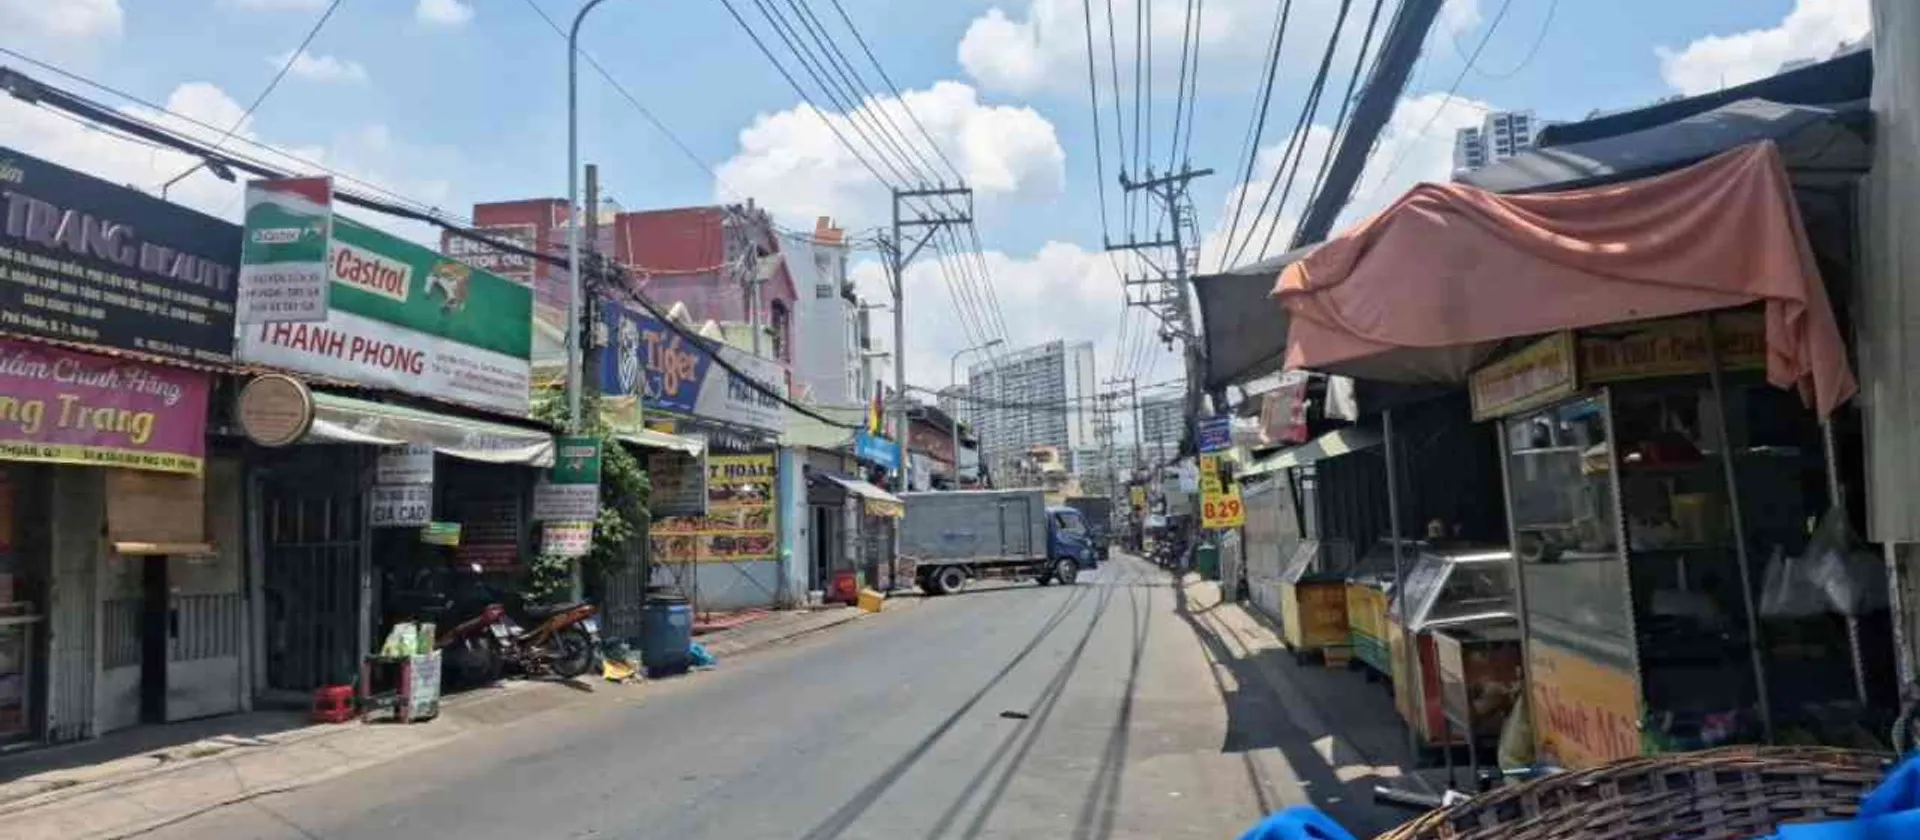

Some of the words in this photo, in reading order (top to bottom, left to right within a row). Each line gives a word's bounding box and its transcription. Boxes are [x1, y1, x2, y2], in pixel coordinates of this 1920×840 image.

[4, 191, 136, 267] TRANG
[139, 241, 232, 292] BEAUTY
[335, 249, 407, 300] Castrol
[260, 320, 347, 361] THANH
[350, 336, 426, 376] PHONG
[645, 329, 699, 397] Tiger
[56, 393, 155, 445] Trang
